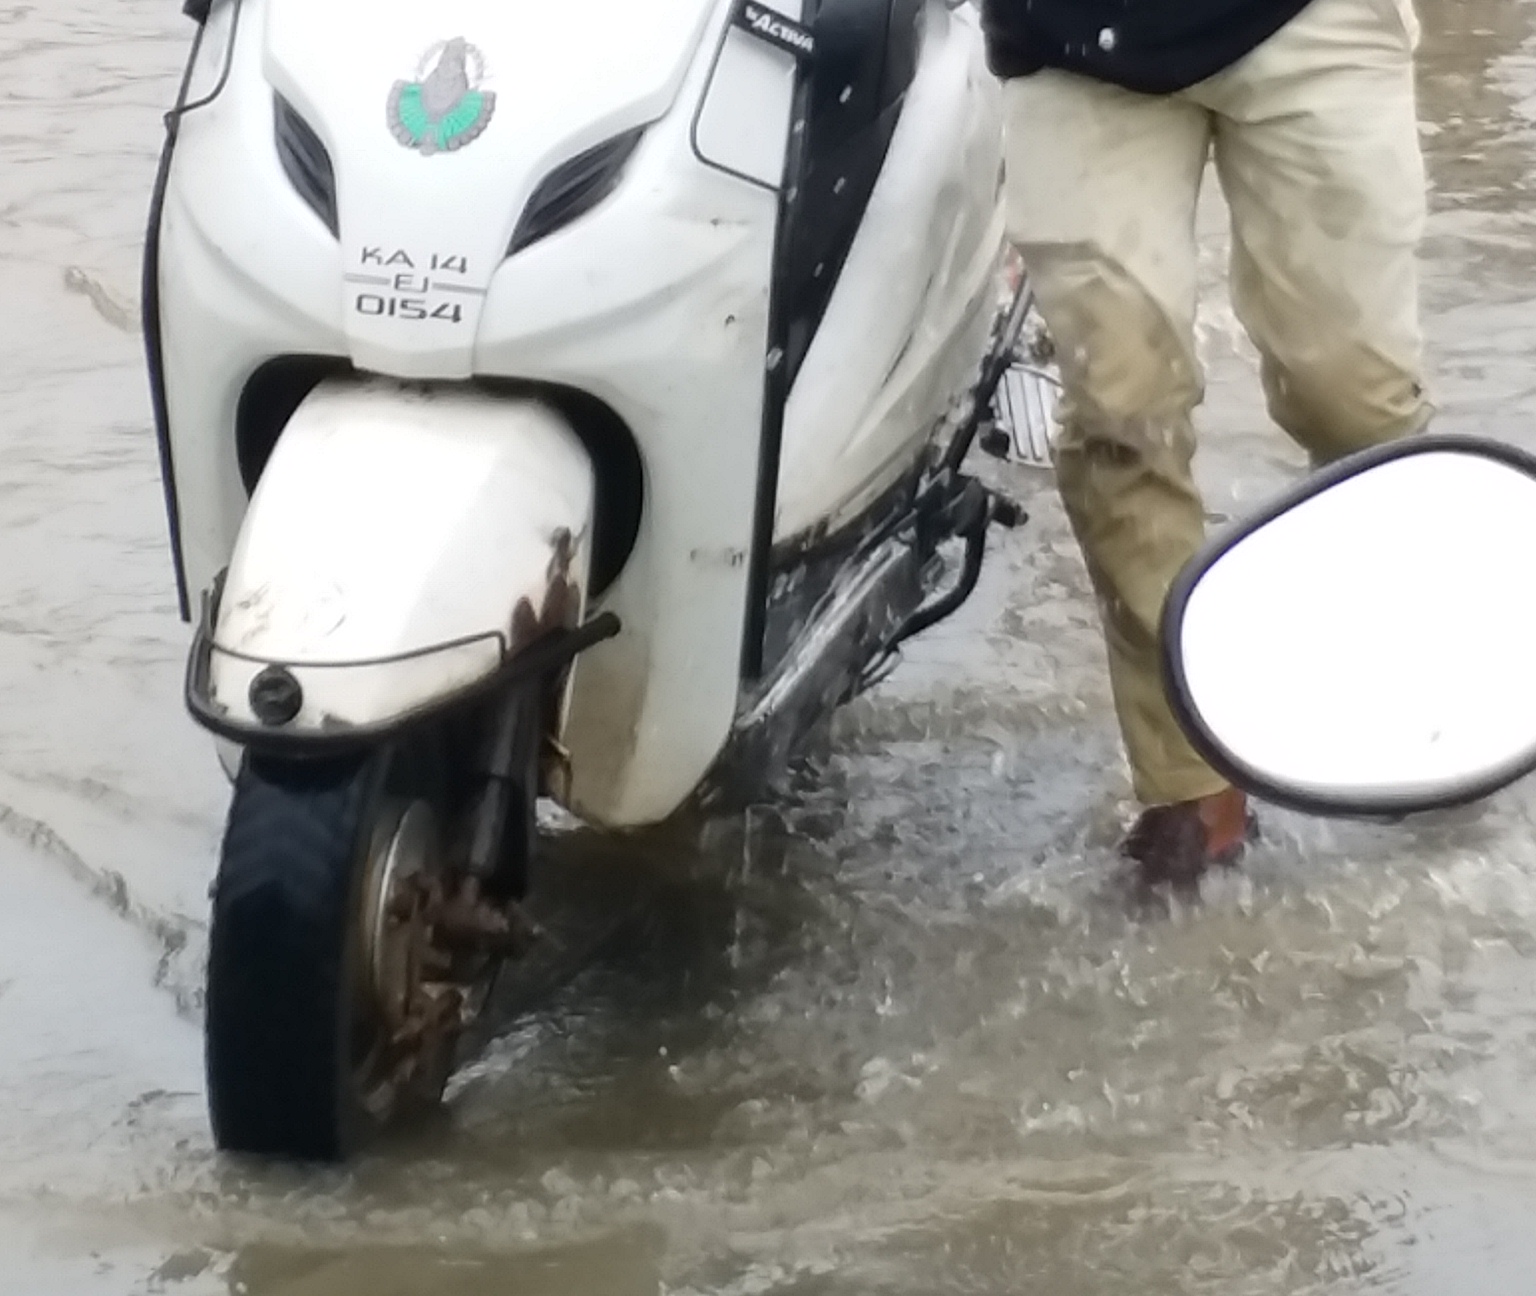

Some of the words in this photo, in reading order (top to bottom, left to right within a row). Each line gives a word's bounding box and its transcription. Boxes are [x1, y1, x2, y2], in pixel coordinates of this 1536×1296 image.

[361, 246, 415, 269] KA
[430, 253, 467, 274] 14
[394, 273, 429, 293] EJ
[356, 294, 463, 323] 0154
